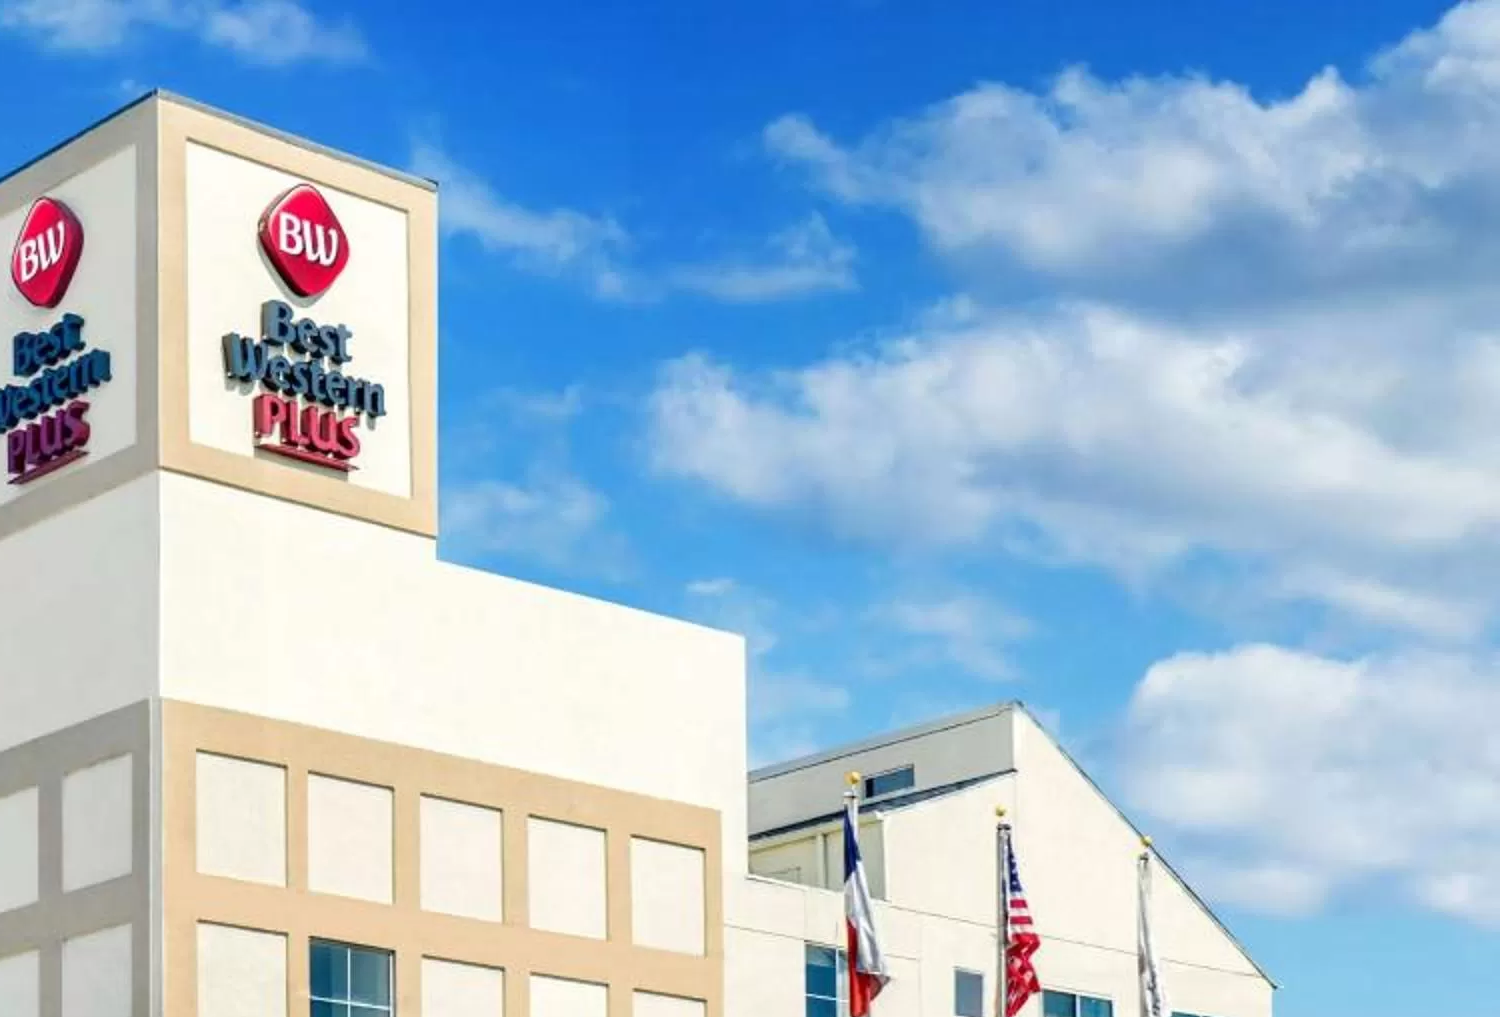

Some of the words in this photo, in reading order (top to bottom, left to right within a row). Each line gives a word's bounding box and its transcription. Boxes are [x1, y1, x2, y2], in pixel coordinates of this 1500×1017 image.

[18, 221, 65, 283] BW
[278, 211, 339, 266] BW
[13, 312, 86, 377] Best
[261, 299, 353, 364] Best
[221, 331, 387, 418] Western
[6, 399, 91, 475] PLUS
[252, 392, 361, 461] PLUS
